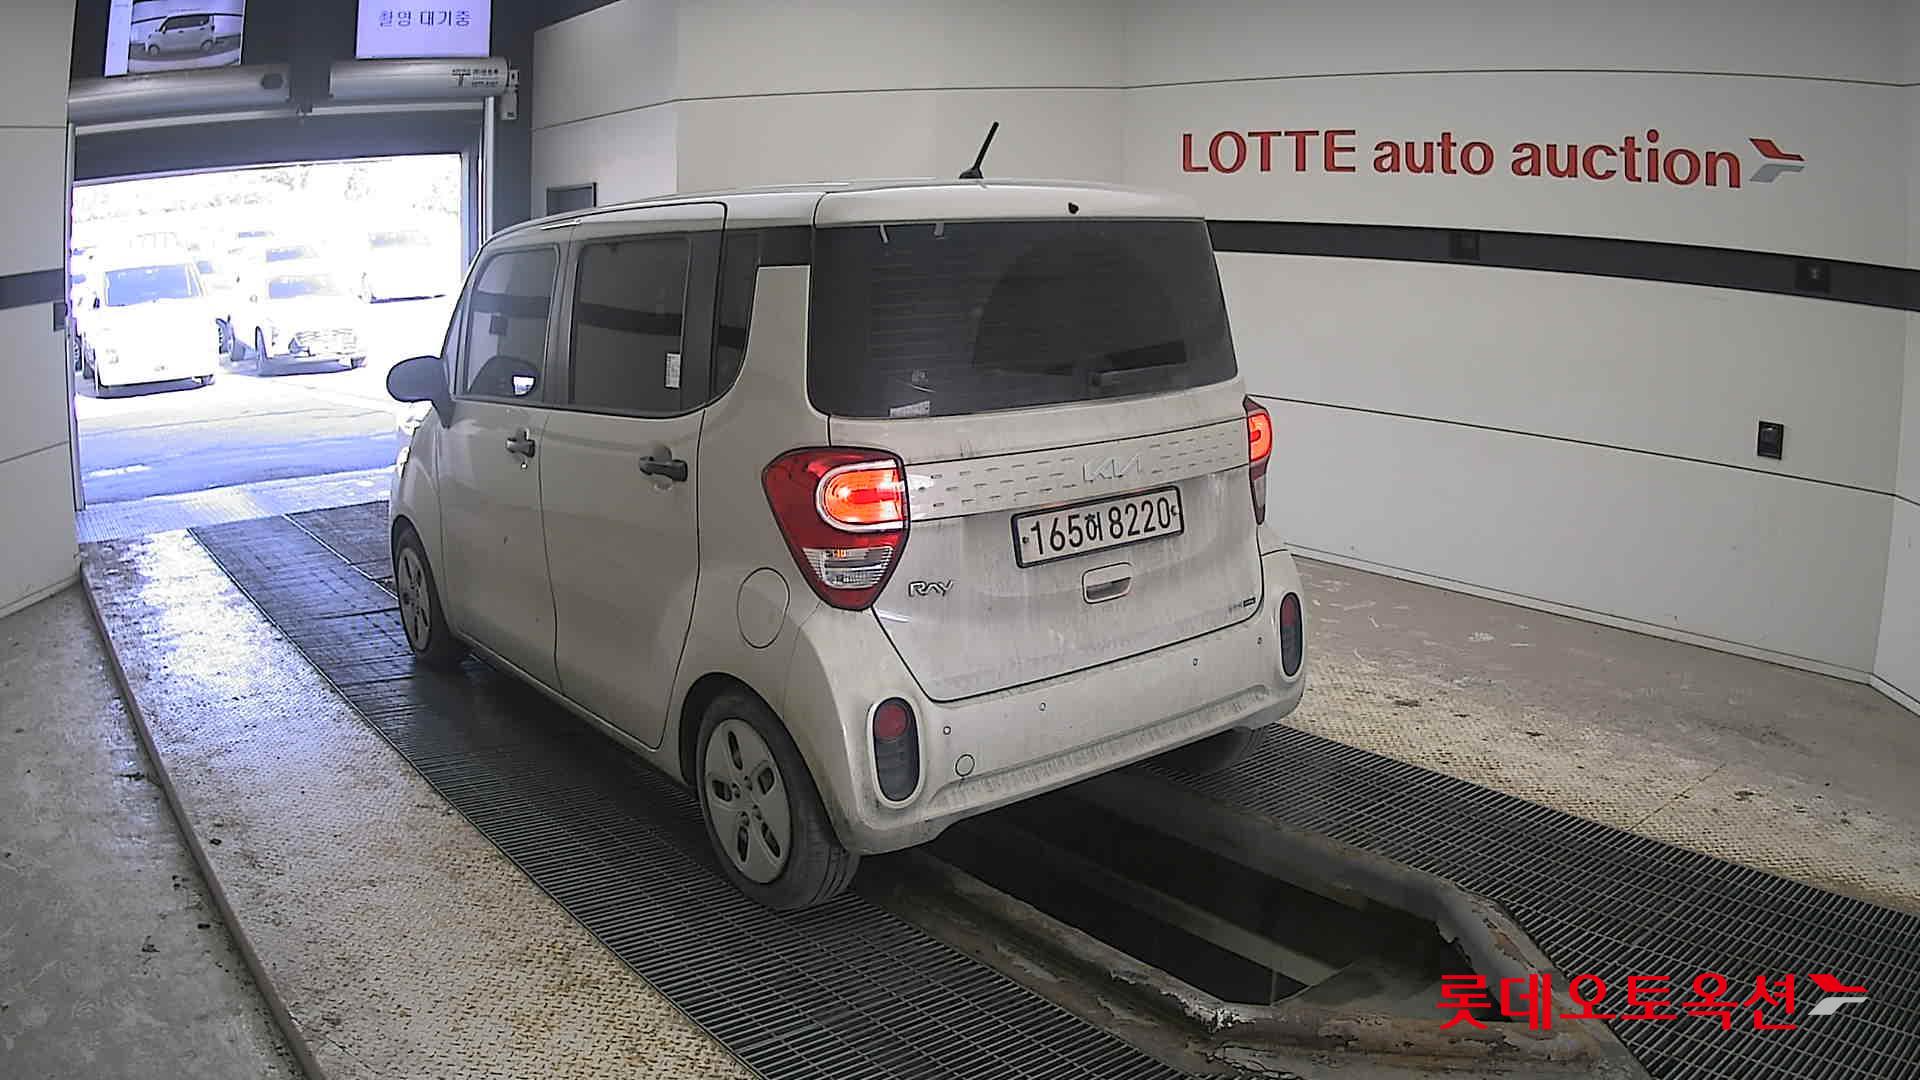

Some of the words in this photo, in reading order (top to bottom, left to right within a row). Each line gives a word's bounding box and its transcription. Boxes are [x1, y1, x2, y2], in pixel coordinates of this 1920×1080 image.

[420, 10, 472, 27] 대기중
[1182, 129, 1357, 174] LOTTE
[1373, 131, 1495, 176] auto
[1511, 128, 1742, 189] auction
[908, 579, 954, 598] RAY
